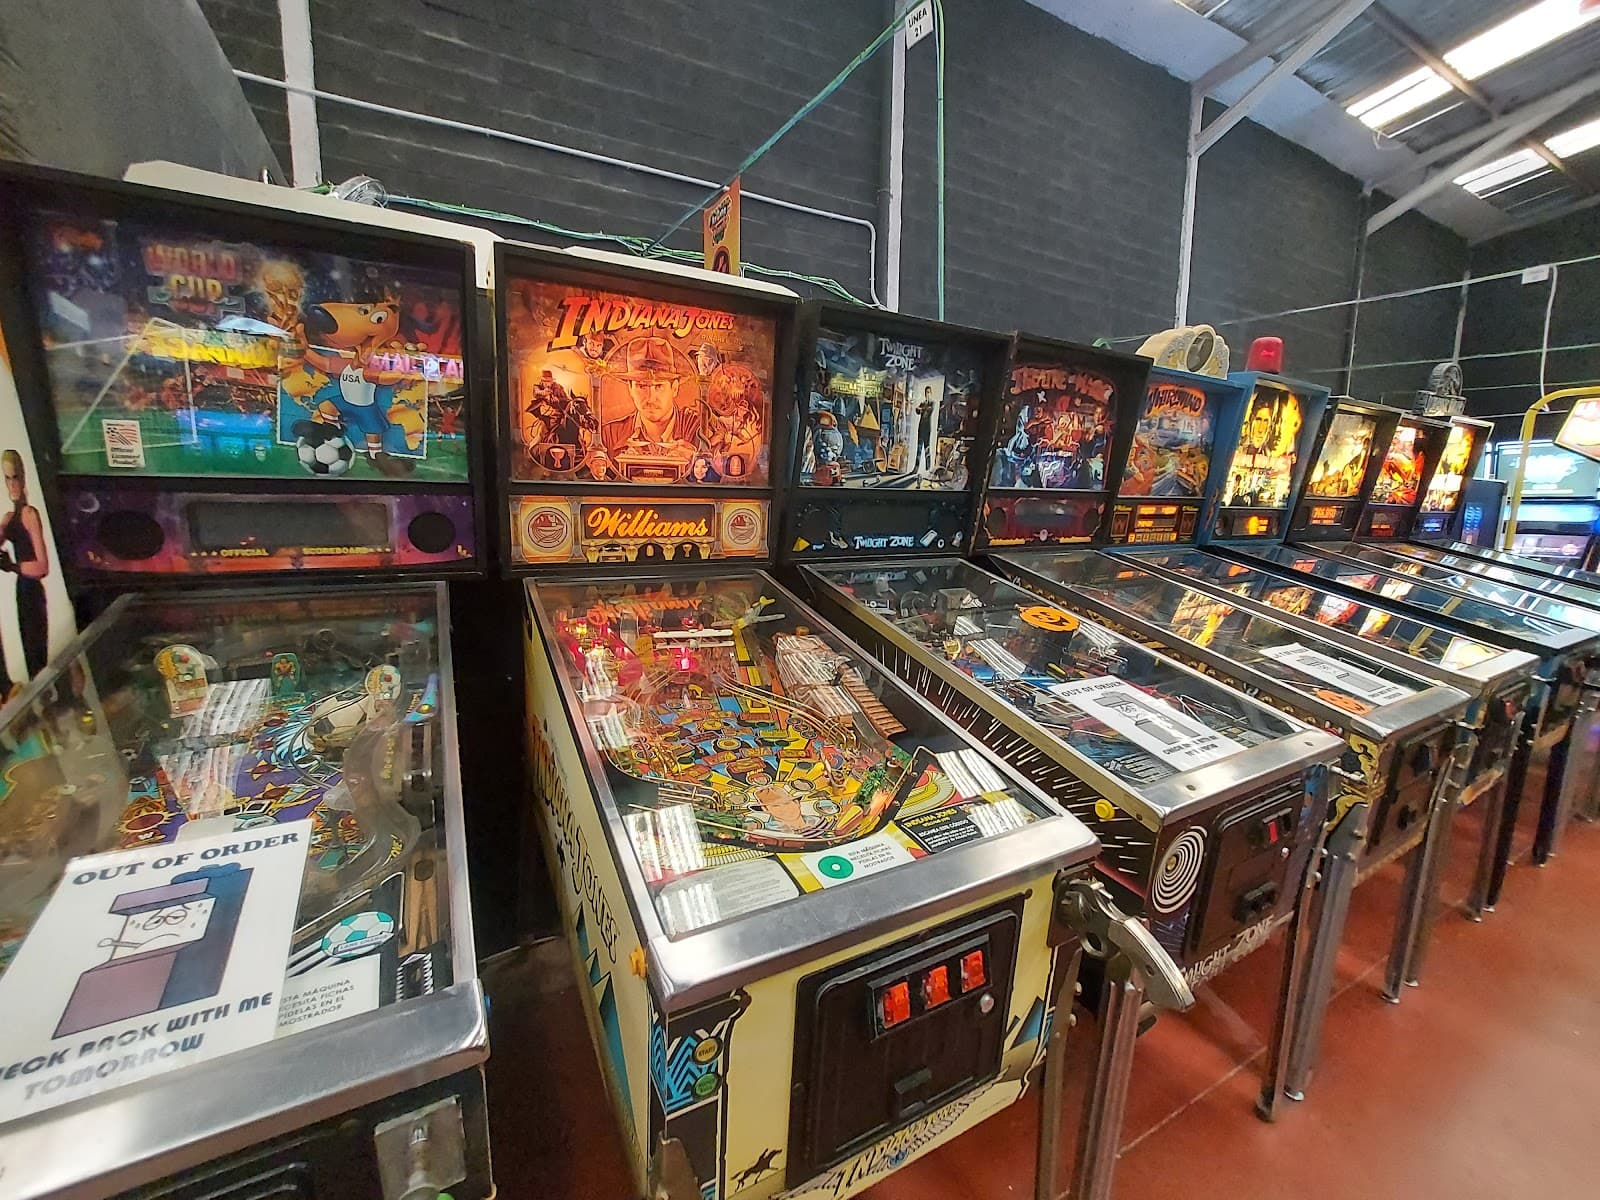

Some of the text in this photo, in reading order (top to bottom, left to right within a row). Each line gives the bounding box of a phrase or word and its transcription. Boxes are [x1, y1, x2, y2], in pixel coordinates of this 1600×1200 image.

[547, 296, 735, 351] INDIANA JONES
[879, 337, 924, 358] TWILIGHT
[885, 353, 918, 371] ZONE
[342, 374, 361, 384] USA
[587, 506, 709, 538] Williams
[889, 536, 915, 547] ZONE
[72, 832, 299, 886] OUT OF ORDER
[0, 992, 273, 1081] ECK BACK WITH ME
[23, 1033, 206, 1101] TOMORROW
